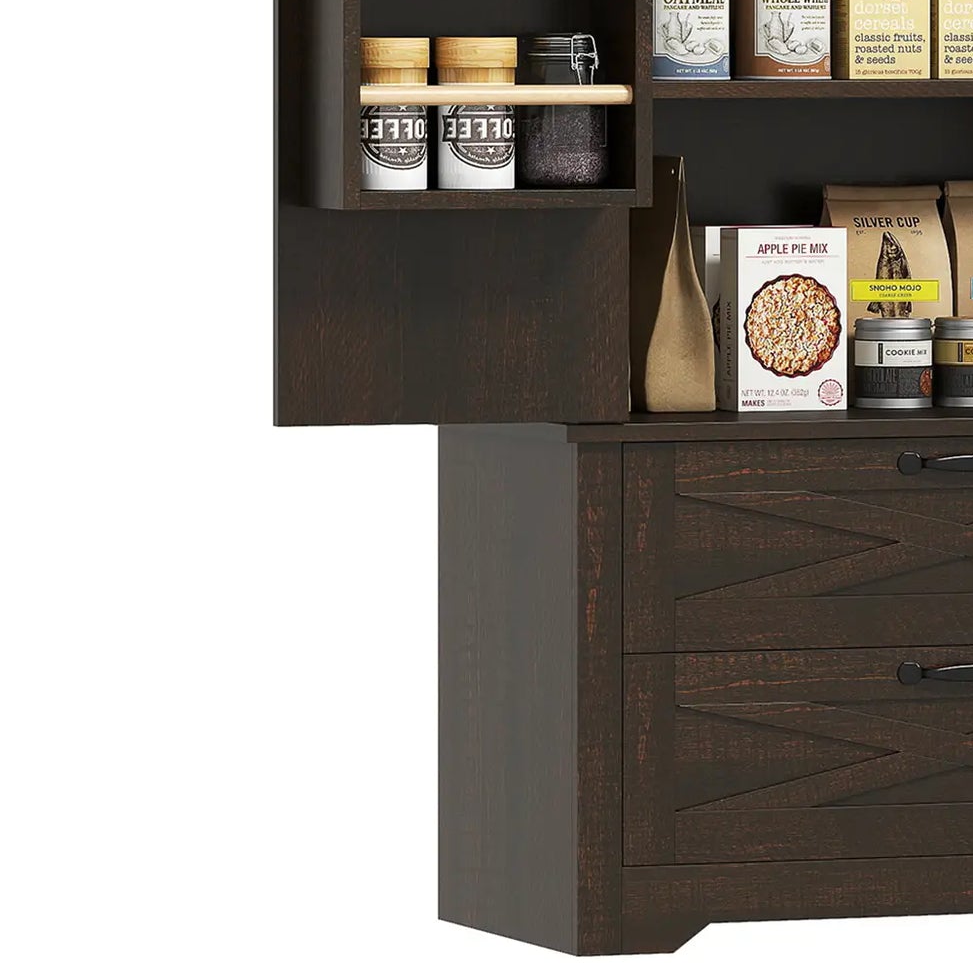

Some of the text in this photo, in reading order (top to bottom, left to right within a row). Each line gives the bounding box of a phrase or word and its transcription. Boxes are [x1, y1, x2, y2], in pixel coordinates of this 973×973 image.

[854, 0, 908, 15] dorset
[854, 16, 915, 30] cereals
[854, 32, 926, 43] classic fruits,
[855, 44, 922, 53] roasted nuts
[854, 55, 896, 64] & seeds
[944, 55, 953, 64] &
[853, 216, 920, 228] SILVER CUP
[757, 243, 828, 255] APPLE PIE MIX
[885, 348, 927, 357] COOKIE MIX
[741, 389, 753, 397] NET
